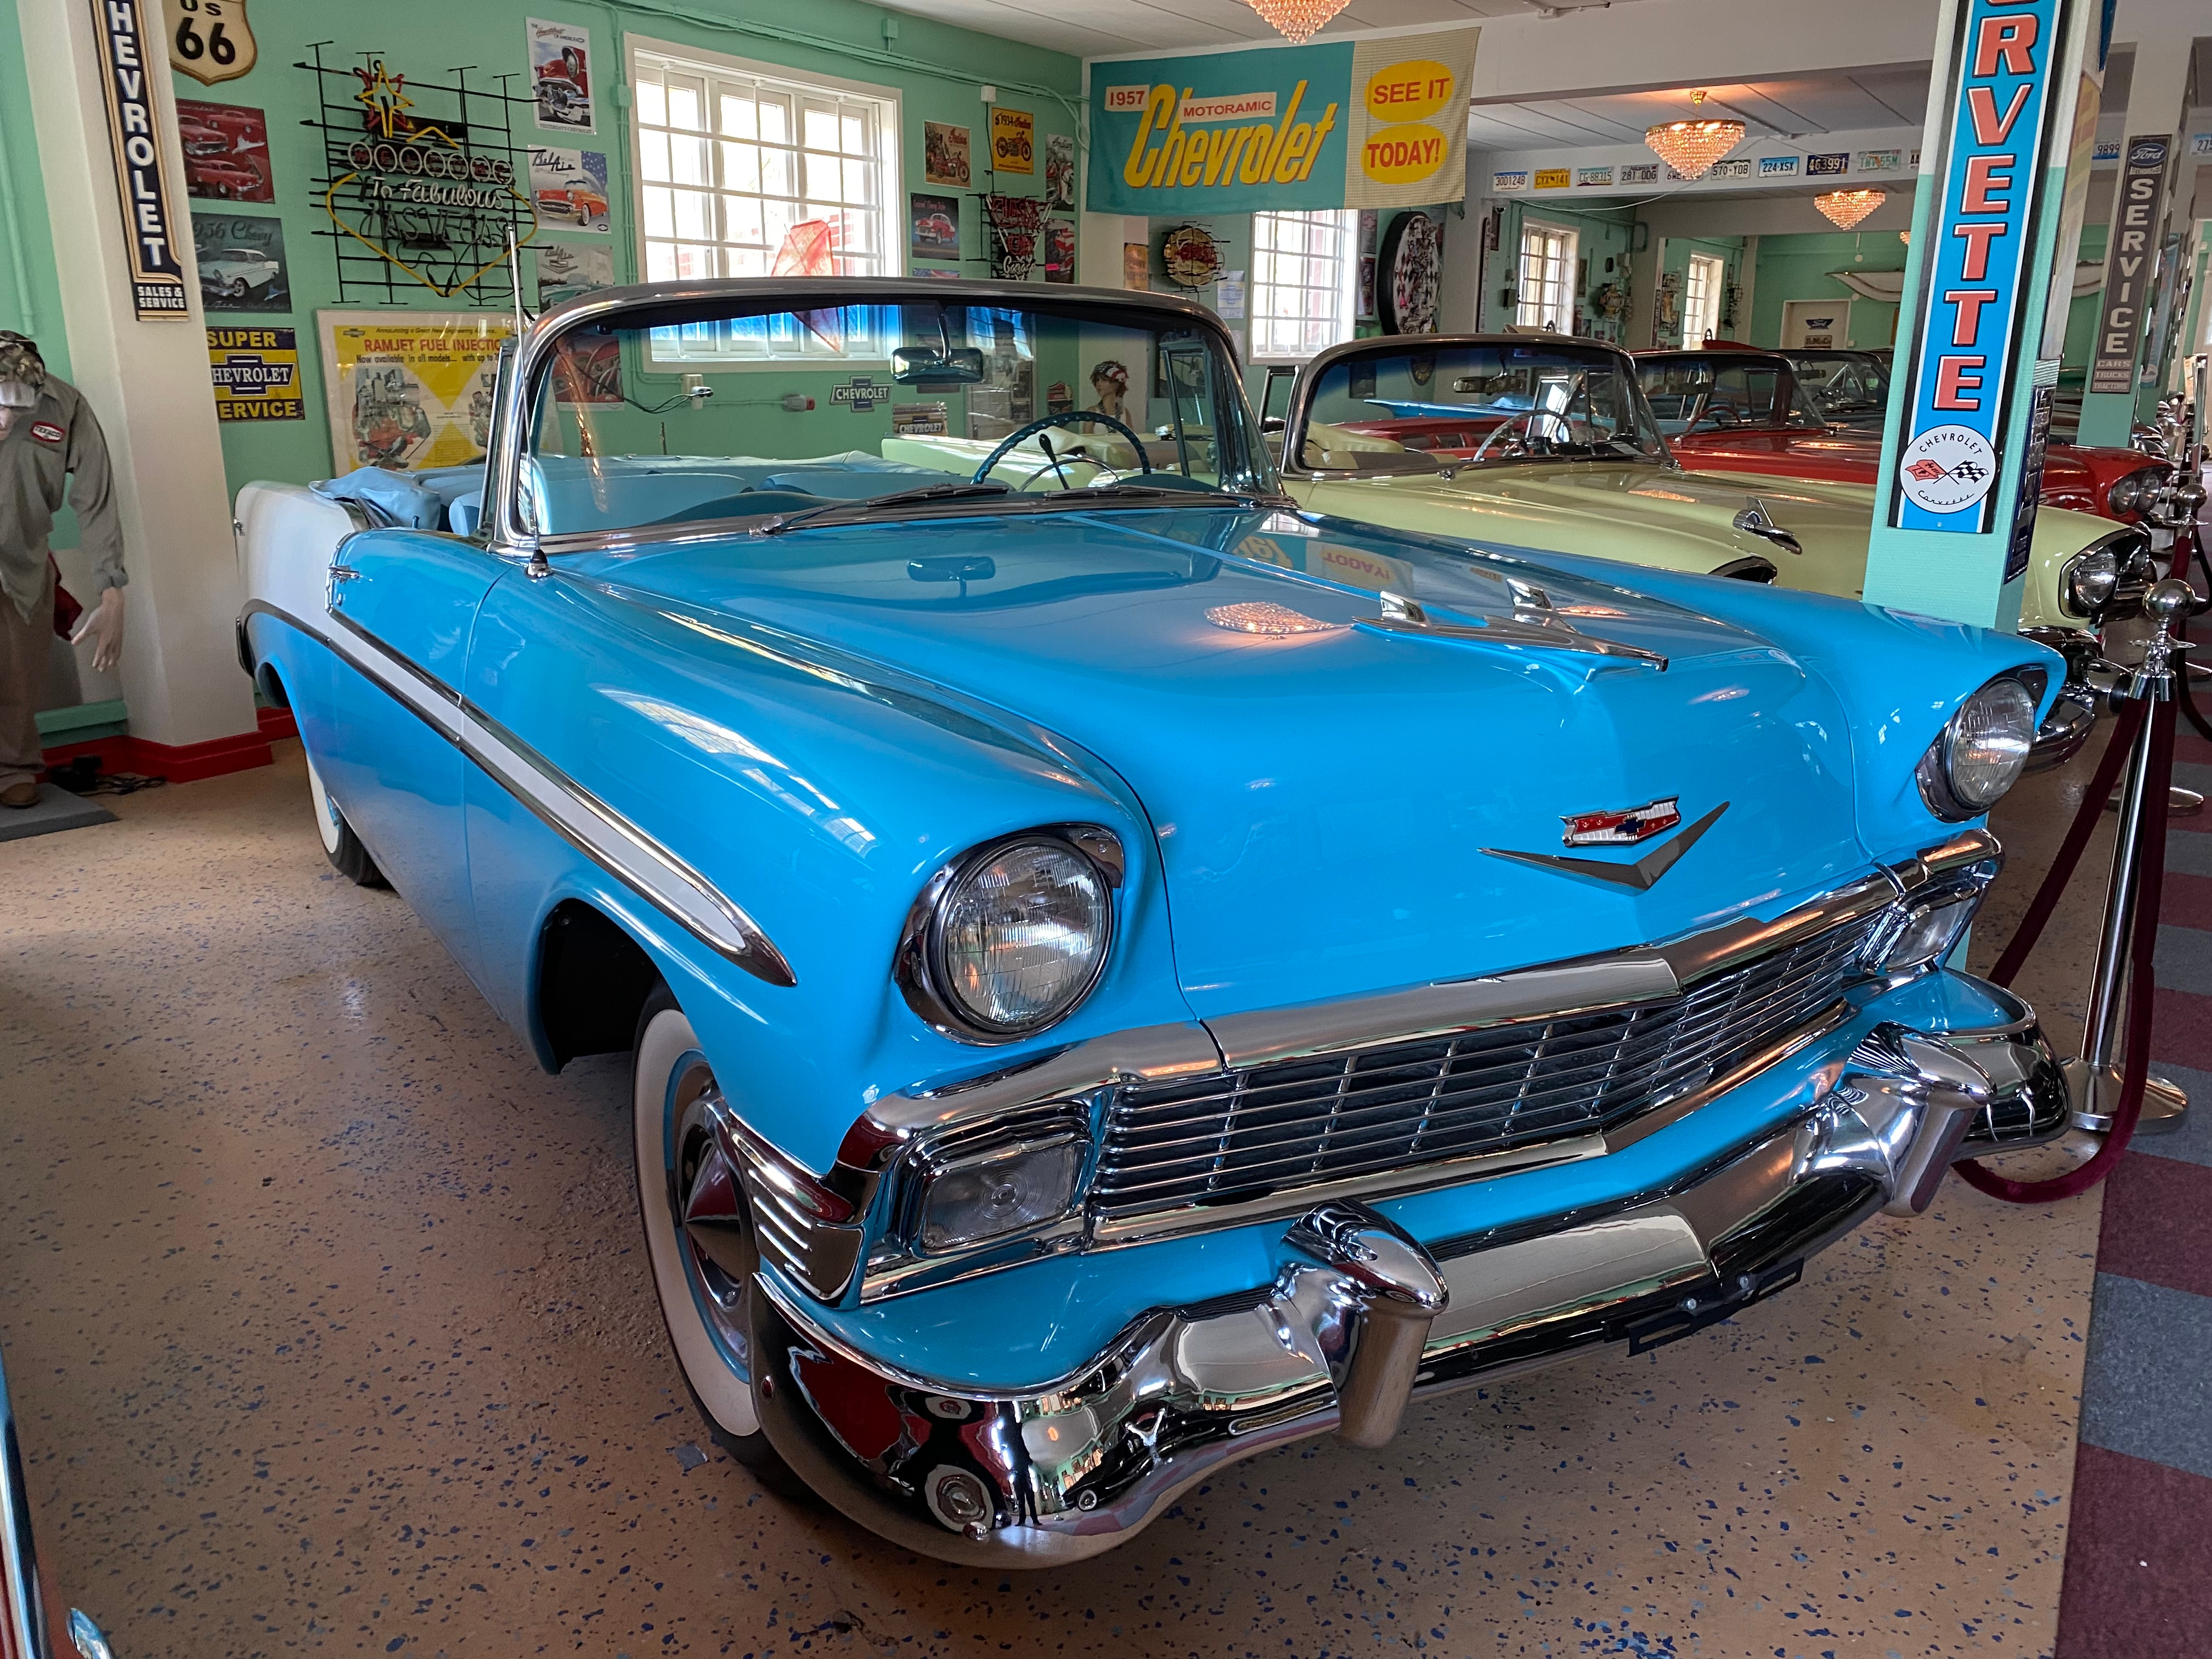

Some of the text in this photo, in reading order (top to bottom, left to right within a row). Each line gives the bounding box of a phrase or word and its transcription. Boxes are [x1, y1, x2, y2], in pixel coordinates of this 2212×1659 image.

[180, 0, 222, 16] US
[176, 17, 235, 65] 66
[1110, 91, 1145, 106] 1957
[1373, 77, 1450, 104] SEE IT
[1183, 100, 1272, 117] MOTORAMIC
[109, 1, 165, 267] HEVROLET
[1123, 80, 1339, 189] Chevrolet
[1368, 138, 1441, 168] TODAY!
[2131, 147, 2164, 160] Ford
[370, 176, 392, 199] To
[1933, 0, 2039, 411] RVETTE
[193, 221, 225, 239] 956
[2105, 178, 2154, 353] SERVICE
[138, 286, 183, 297] SALES &
[139, 297, 185, 308] SERVICE
[206, 331, 277, 347] SUPER
[364, 338, 500, 352] RAMJET FUEL INJECTIO
[356, 354, 371, 363] Now
[374, 353, 404, 363] available
[212, 368, 289, 383] HEVROLET
[836, 387, 889, 400] CHEVROLET
[218, 402, 297, 419] ERVICE
[899, 422, 943, 433] CHEVROLET
[1919, 433, 1982, 454] CHEVROLET
[1918, 490, 1974, 505] Corvette
